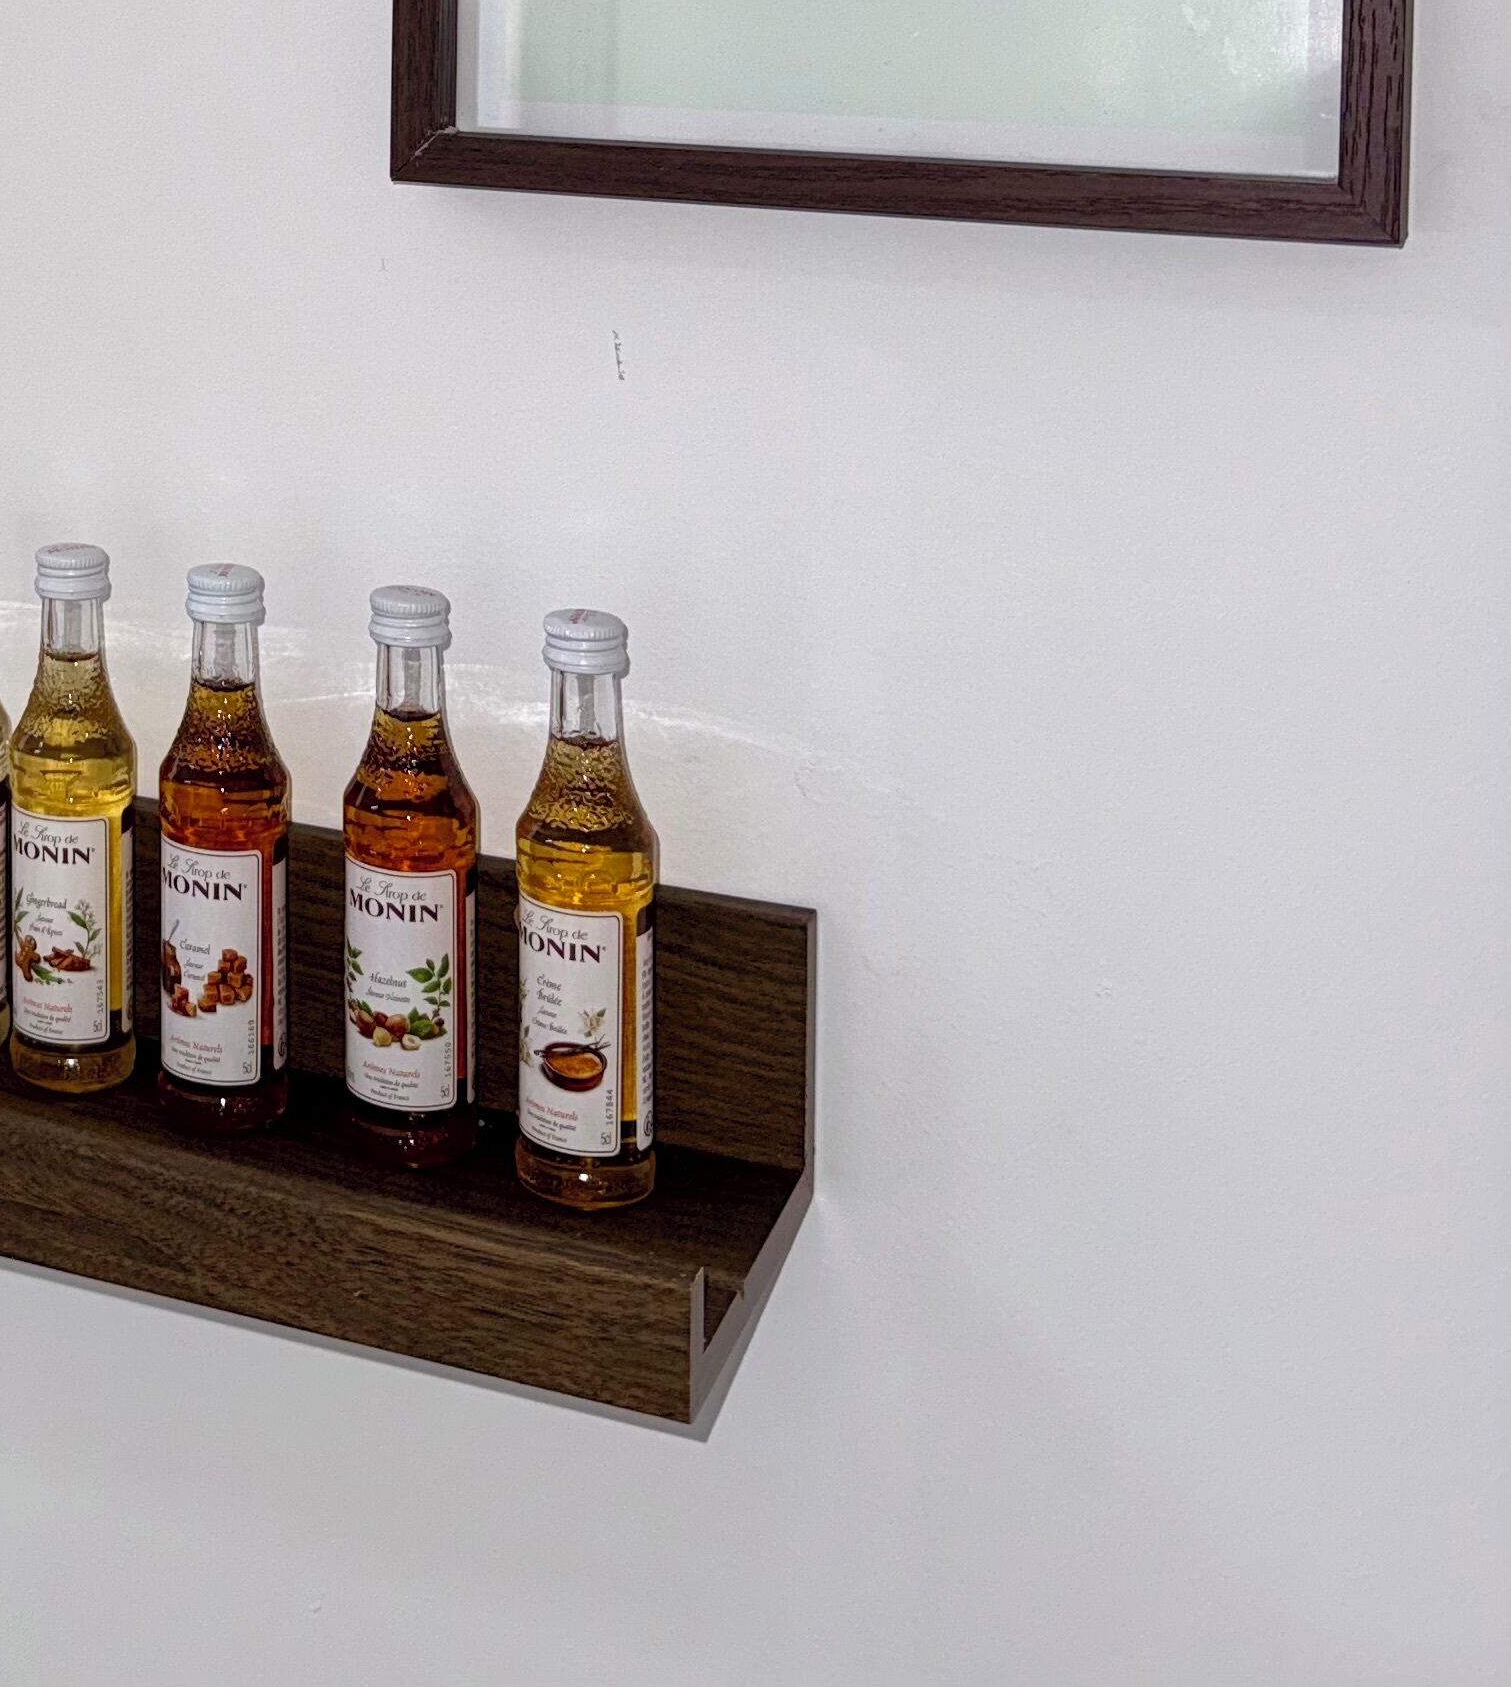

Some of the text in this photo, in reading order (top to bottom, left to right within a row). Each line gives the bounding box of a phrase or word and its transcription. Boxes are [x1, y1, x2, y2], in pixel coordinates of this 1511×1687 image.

[356, 876, 372, 893] Le
[373, 880, 408, 903] Sirop
[350, 888, 439, 923] MONIN
